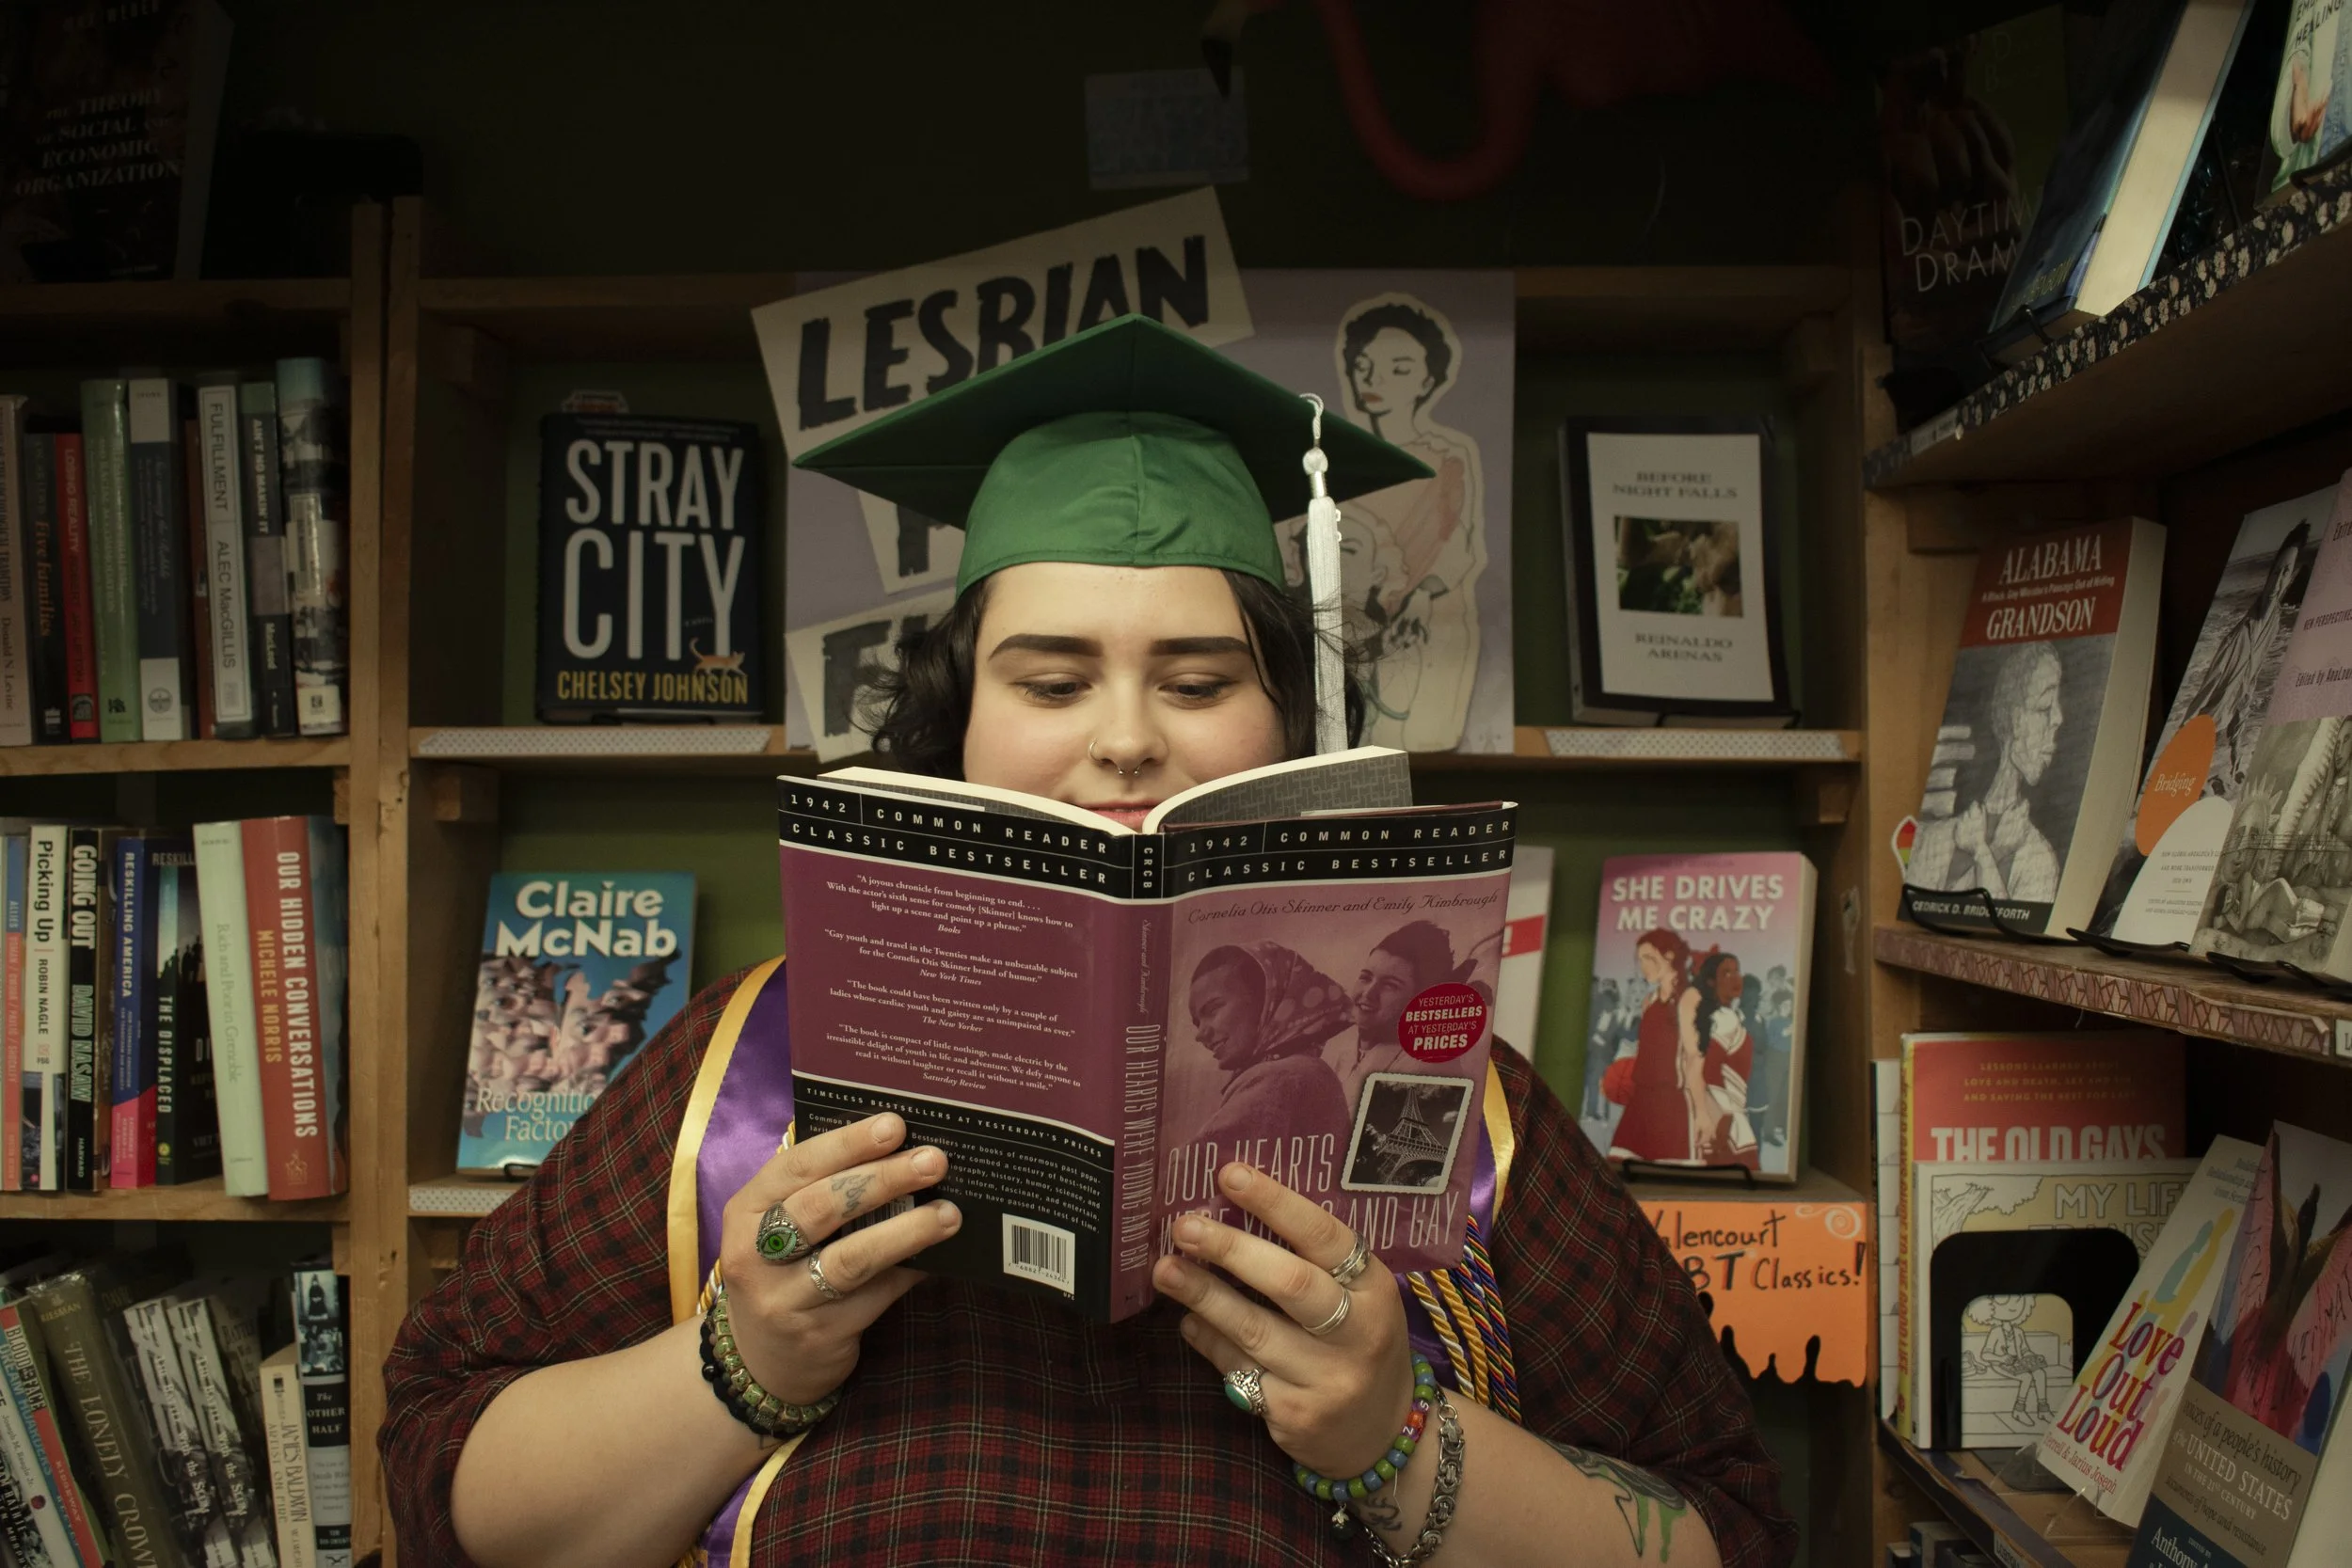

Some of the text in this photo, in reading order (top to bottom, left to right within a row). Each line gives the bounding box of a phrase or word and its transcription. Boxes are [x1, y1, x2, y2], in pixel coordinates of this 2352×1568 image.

[77, 87, 161, 115] THEORY
[59, 116, 137, 140] SOCIAL
[41, 139, 158, 169] ECONOMIC
[15, 159, 182, 197] ORGANIZATION
[1901, 193, 2032, 257] DAYTIM
[1915, 237, 2018, 293] DRAM
[798, 235, 1209, 431] LESBIAN
[209, 403, 229, 511] FULFILLMENT
[253, 454, 265, 471] NO
[1636, 471, 1711, 483] BEFORE
[63, 449, 79, 553] LOSING REALITY
[565, 438, 744, 531] STRAY
[1613, 484, 1738, 499] NIGHT FALLS
[34, 520, 50, 557] Five
[258, 521, 269, 533] IT
[1998, 533, 2103, 585] ALABAMA
[36, 562, 55, 636] Families
[217, 540, 236, 669] ALEC MacGILLIS
[563, 528, 745, 660] CITY
[1986, 596, 2096, 641] GRANDSON
[262, 622, 278, 671] MacLeod
[1634, 632, 1733, 649] REINALDO
[1648, 648, 1723, 663] ARENAS
[557, 670, 749, 705] CHELSEY JOHNSON
[2154, 772, 2197, 798] Bridging
[791, 795, 1105, 854] 1942 COMMON READER
[1190, 821, 1509, 853] 1942 COMMON READER
[793, 823, 1105, 883] CLASSIC BESTSELLER
[1143, 847, 1153, 888] CRCB
[1188, 850, 1505, 882] CLASSIC BESTSELLER
[33, 841, 53, 942] Picking Up
[71, 845, 96, 950] GOING OUT
[122, 852, 135, 932] RESKILLING
[516, 880, 664, 919] Claire
[827, 881, 847, 892] With
[849, 885, 861, 894] the
[889, 893, 908, 901] sixth
[910, 896, 930, 906] sense
[931, 898, 944, 908] for
[946, 902, 976, 914] comedy
[1018, 912, 1044, 924] knows
[1045, 916, 1063, 927] how
[1065, 920, 1073, 928] to
[868, 877, 894, 887] joyous
[896, 881, 932, 894] chronicle
[934, 886, 954, 897] from
[955, 890, 995, 905] beginning
[1188, 888, 1501, 925] Cornelia Otis Skinner and Emily Kimbrough
[1611, 874, 1785, 902] SHE DRIVES
[8, 900, 18, 928] ALLIES
[938, 924, 961, 934] Books
[1616, 905, 1776, 931] ME CRAZY
[1912, 900, 1949, 913] CEDRICK
[1963, 905, 2030, 920] BRIDFORTH
[495, 919, 678, 958] McNab
[121, 937, 134, 998] AMERICA
[920, 969, 981, 986] New York Times
[37, 959, 47, 1034] ROBIN NAGLE
[215, 924, 242, 1084] Rich and Poor in Grenoble
[255, 929, 281, 1064] MICHELE NORRIS
[276, 851, 317, 1138] OUR HIDDEN CONVERSATIONS
[1406, 1006, 1482, 1022] BESTSELLERS
[1419, 994, 1474, 1006] YESTERDAY'S
[70, 984, 92, 1102] DAVID NASAW
[1408, 1021, 1477, 1034] AT YESTERDAY'S
[1413, 1034, 1468, 1051] PRICES
[156, 995, 172, 1113] THE DISPLACED
[923, 1072, 986, 1089] Saturday Review
[475, 1087, 597, 1121] Recognitio
[806, 1087, 864, 1103] TIMELESS
[870, 1100, 951, 1120] BESTSELLERS
[977, 1119, 1057, 1142] YESTERDAY'S
[1064, 1137, 1102, 1158] PRICES
[76, 1137, 85, 1178] HARVARD
[1120, 1024, 1160, 1272] OUR HEARTS WERE YOUNG AND GAY
[1931, 1127, 1998, 1162] THE
[2080, 1124, 2166, 1162] GAYS
[1165, 1142, 1218, 1206] OUR
[1348, 1196, 1398, 1250] AND
[1409, 1191, 1459, 1248] GAY
[2055, 1182, 2117, 1219] MY
[2125, 1181, 2189, 1217] LIF
[1683, 1241, 1867, 1291] BT Classics!
[2110, 1302, 2185, 1375] Love
[5, 1324, 46, 1411] BLOOD FACE
[2091, 1353, 2156, 1421] Out
[64, 1341, 92, 1384] THE
[80, 1394, 129, 1480] LONELY
[307, 1406, 345, 1418] OTHER
[311, 1422, 342, 1434] HALF
[2057, 1385, 2144, 1471] Loud
[224, 1463, 236, 1480] the
[281, 1424, 307, 1523] JAMES BALDWIN
[2090, 1464, 2118, 1495] Joseph
[2187, 1434, 2294, 1520] UNITED STATES
[2261, 1444, 2301, 1496] history
[55, 1460, 82, 1522] RIDGEWAY
[2151, 1527, 2198, 1568] Anthony
